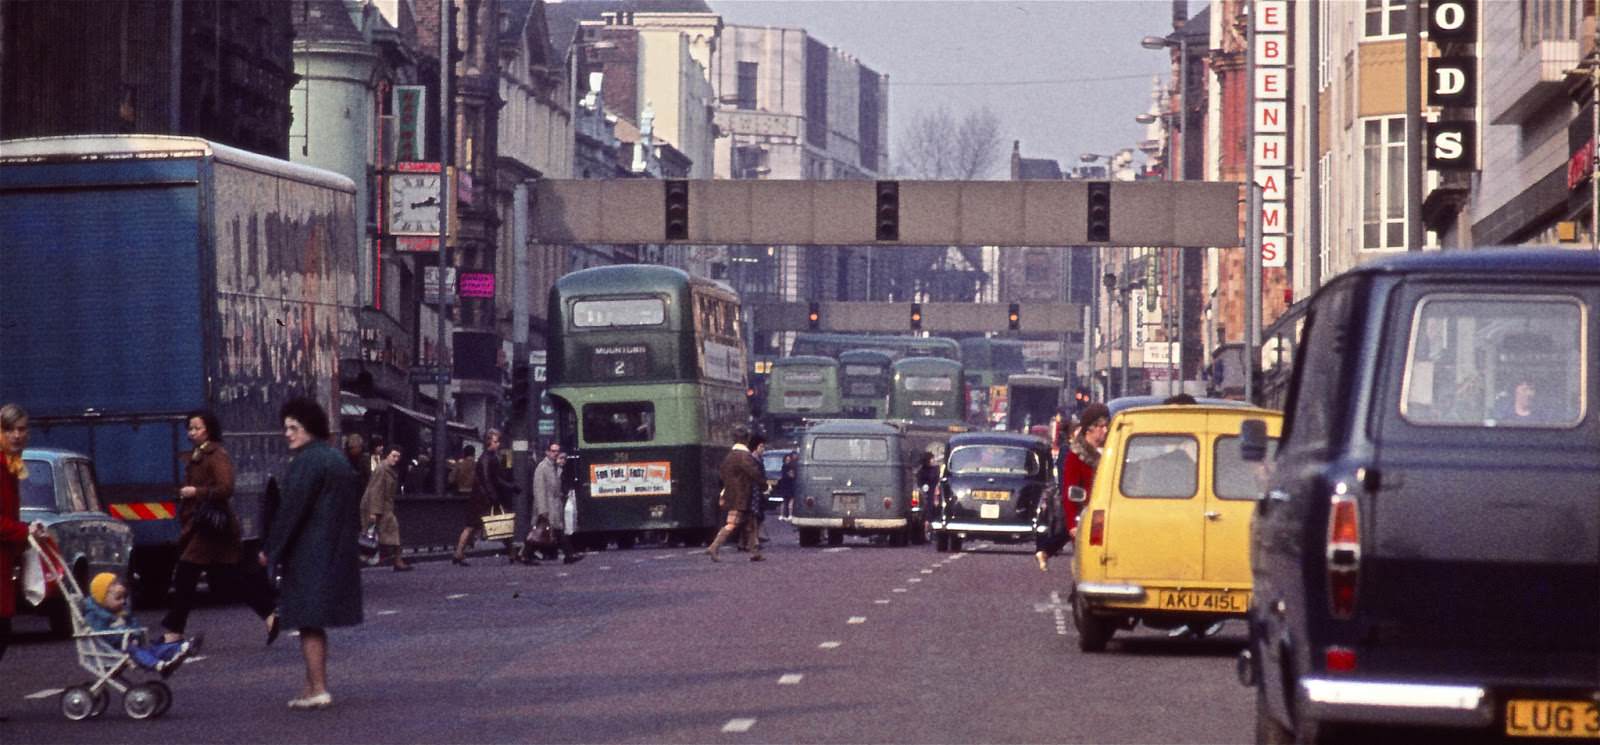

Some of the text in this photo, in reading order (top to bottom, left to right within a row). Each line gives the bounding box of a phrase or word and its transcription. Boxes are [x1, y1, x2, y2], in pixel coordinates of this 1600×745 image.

[1435, 3, 1465, 159] ODS
[615, 361, 625, 375] 2
[1166, 592, 1241, 610] AKU 415L
[1511, 703, 1574, 732] LUG
